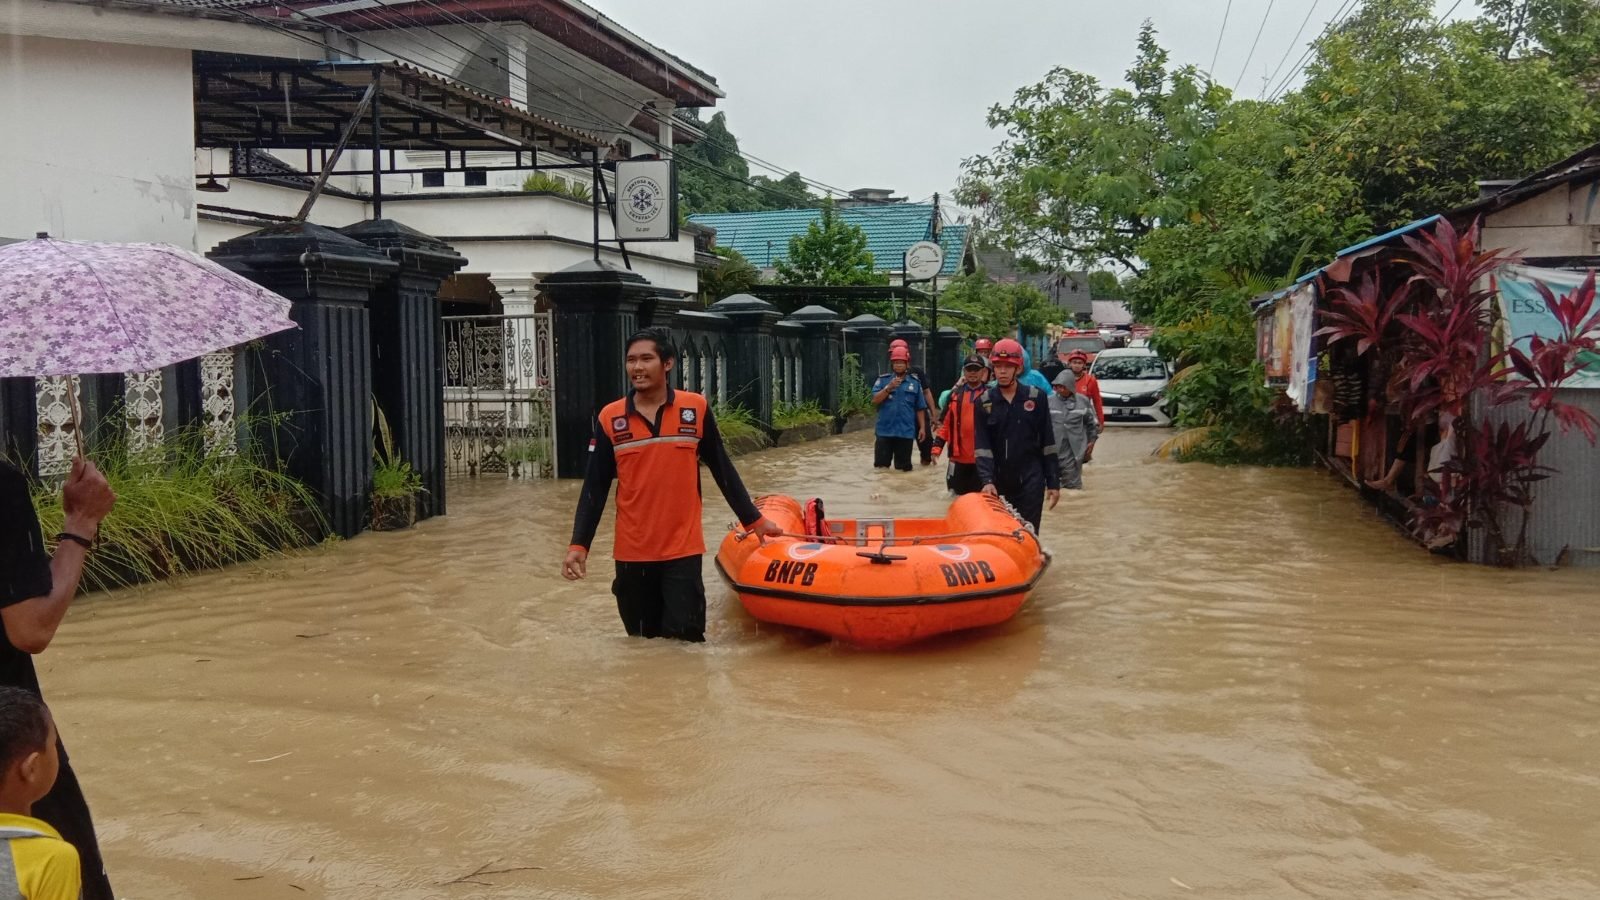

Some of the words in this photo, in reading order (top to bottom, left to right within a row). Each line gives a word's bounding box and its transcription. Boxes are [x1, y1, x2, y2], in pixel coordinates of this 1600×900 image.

[1512, 299, 1551, 313] ESS
[764, 560, 818, 586] BNPB
[939, 560, 995, 587] BNPB
